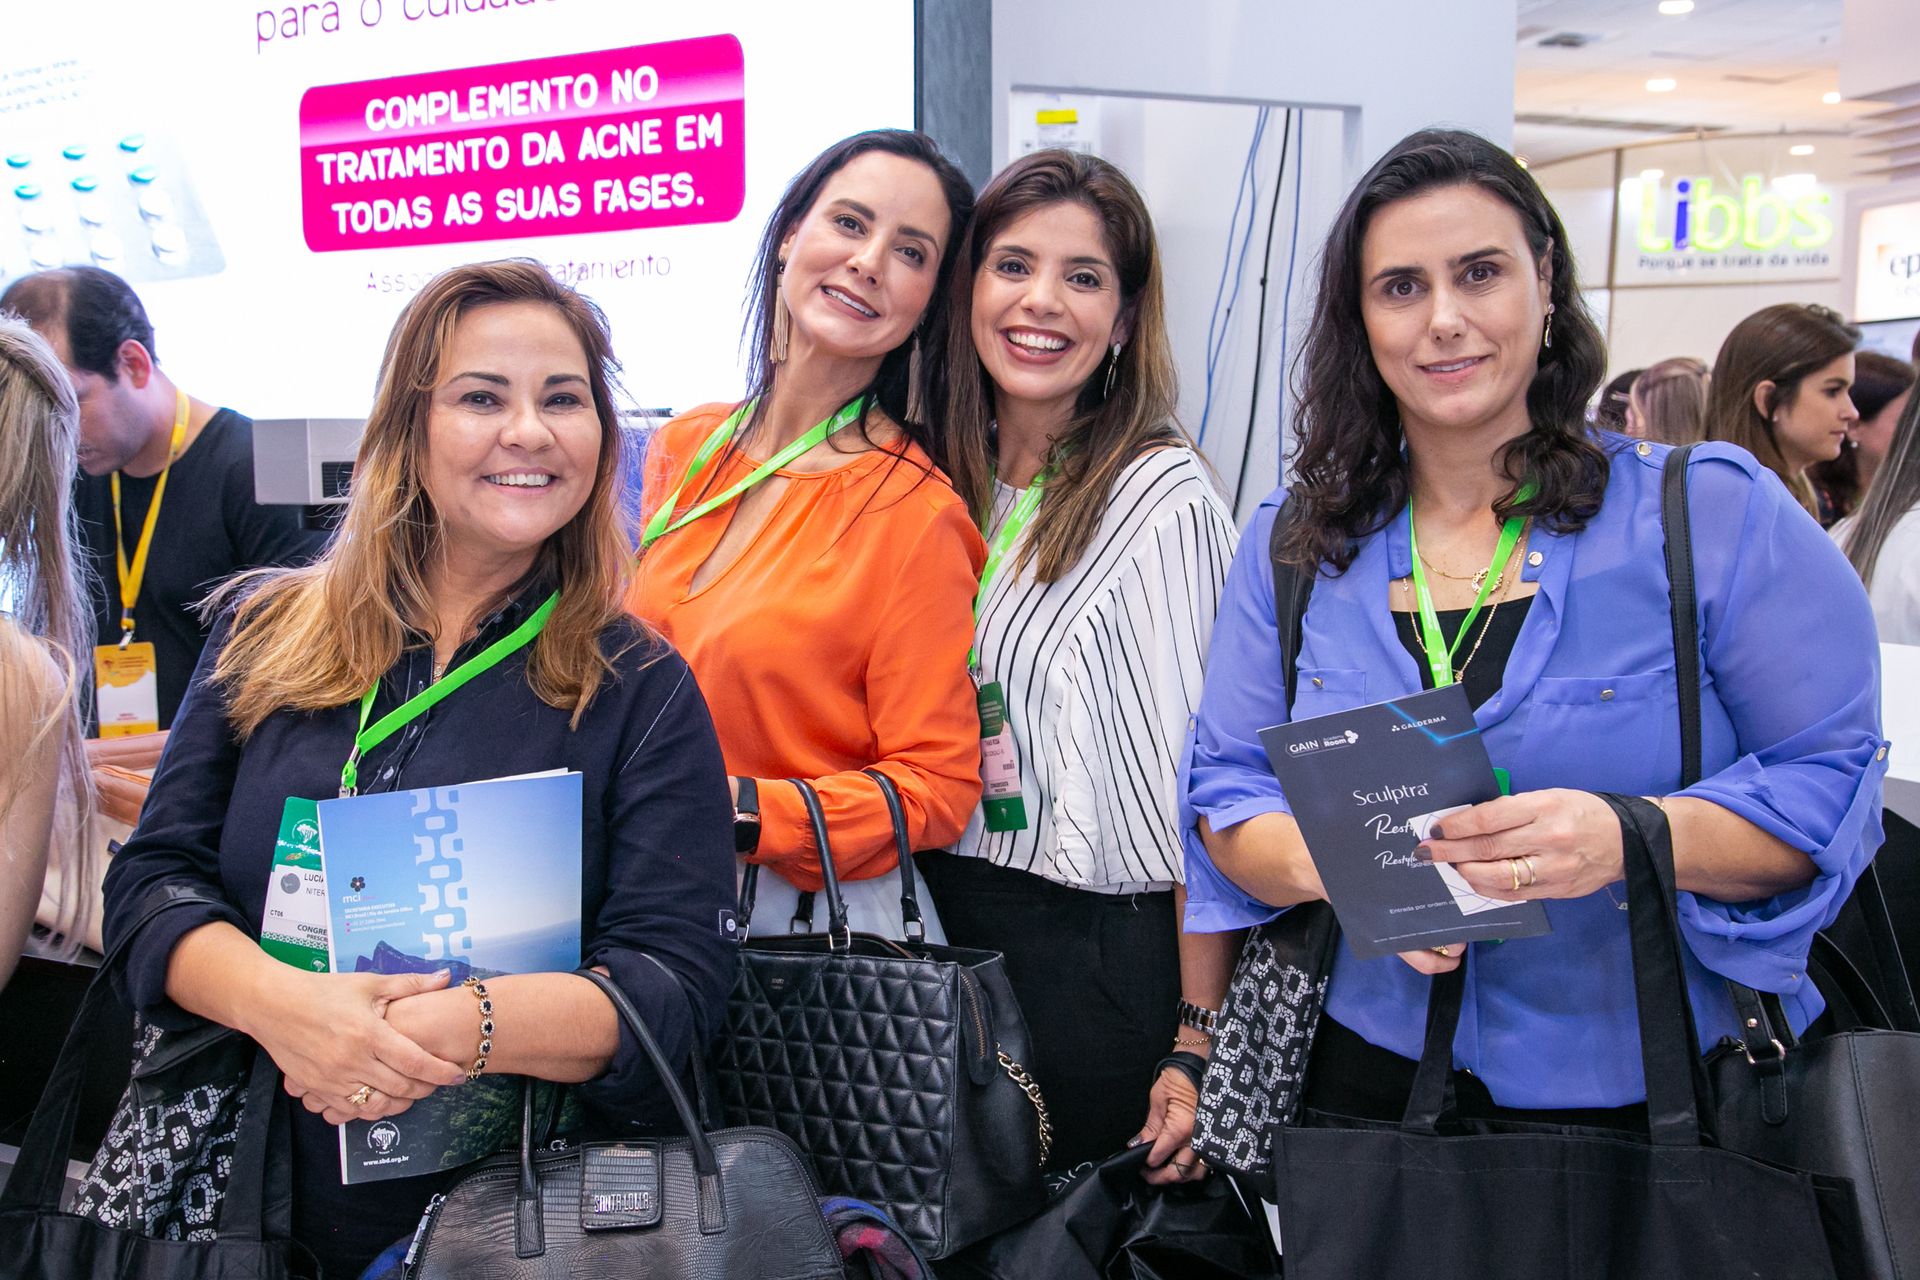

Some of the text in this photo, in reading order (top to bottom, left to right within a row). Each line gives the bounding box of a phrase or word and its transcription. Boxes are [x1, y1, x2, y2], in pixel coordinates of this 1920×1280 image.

[256, 2, 340, 54] para
[365, 65, 658, 132] COMPLEMENTO NO
[315, 112, 722, 185] TRATAMENTO DA ACNE EM
[331, 172, 704, 235] TODAS AS SUAS FASES.
[1638, 176, 1833, 253] Libbs
[1638, 252, 1829, 270] Porque se trata da vida
[1889, 253, 1920, 279] ep
[367, 271, 433, 293] Assoc
[1401, 715, 1447, 730] GALDERMA
[1289, 740, 1319, 753] GAIN
[1323, 738, 1347, 747] Room
[1353, 783, 1429, 806] Sculptra
[305, 888, 326, 897] NITER
[342, 892, 361, 904] mci
[1389, 905, 1415, 914] Entrada
[1415, 903, 1426, 911] por
[1427, 900, 1448, 908] ordem
[297, 924, 328, 936] CONGRE
[594, 1192, 649, 1213] SANTA LOLLA
